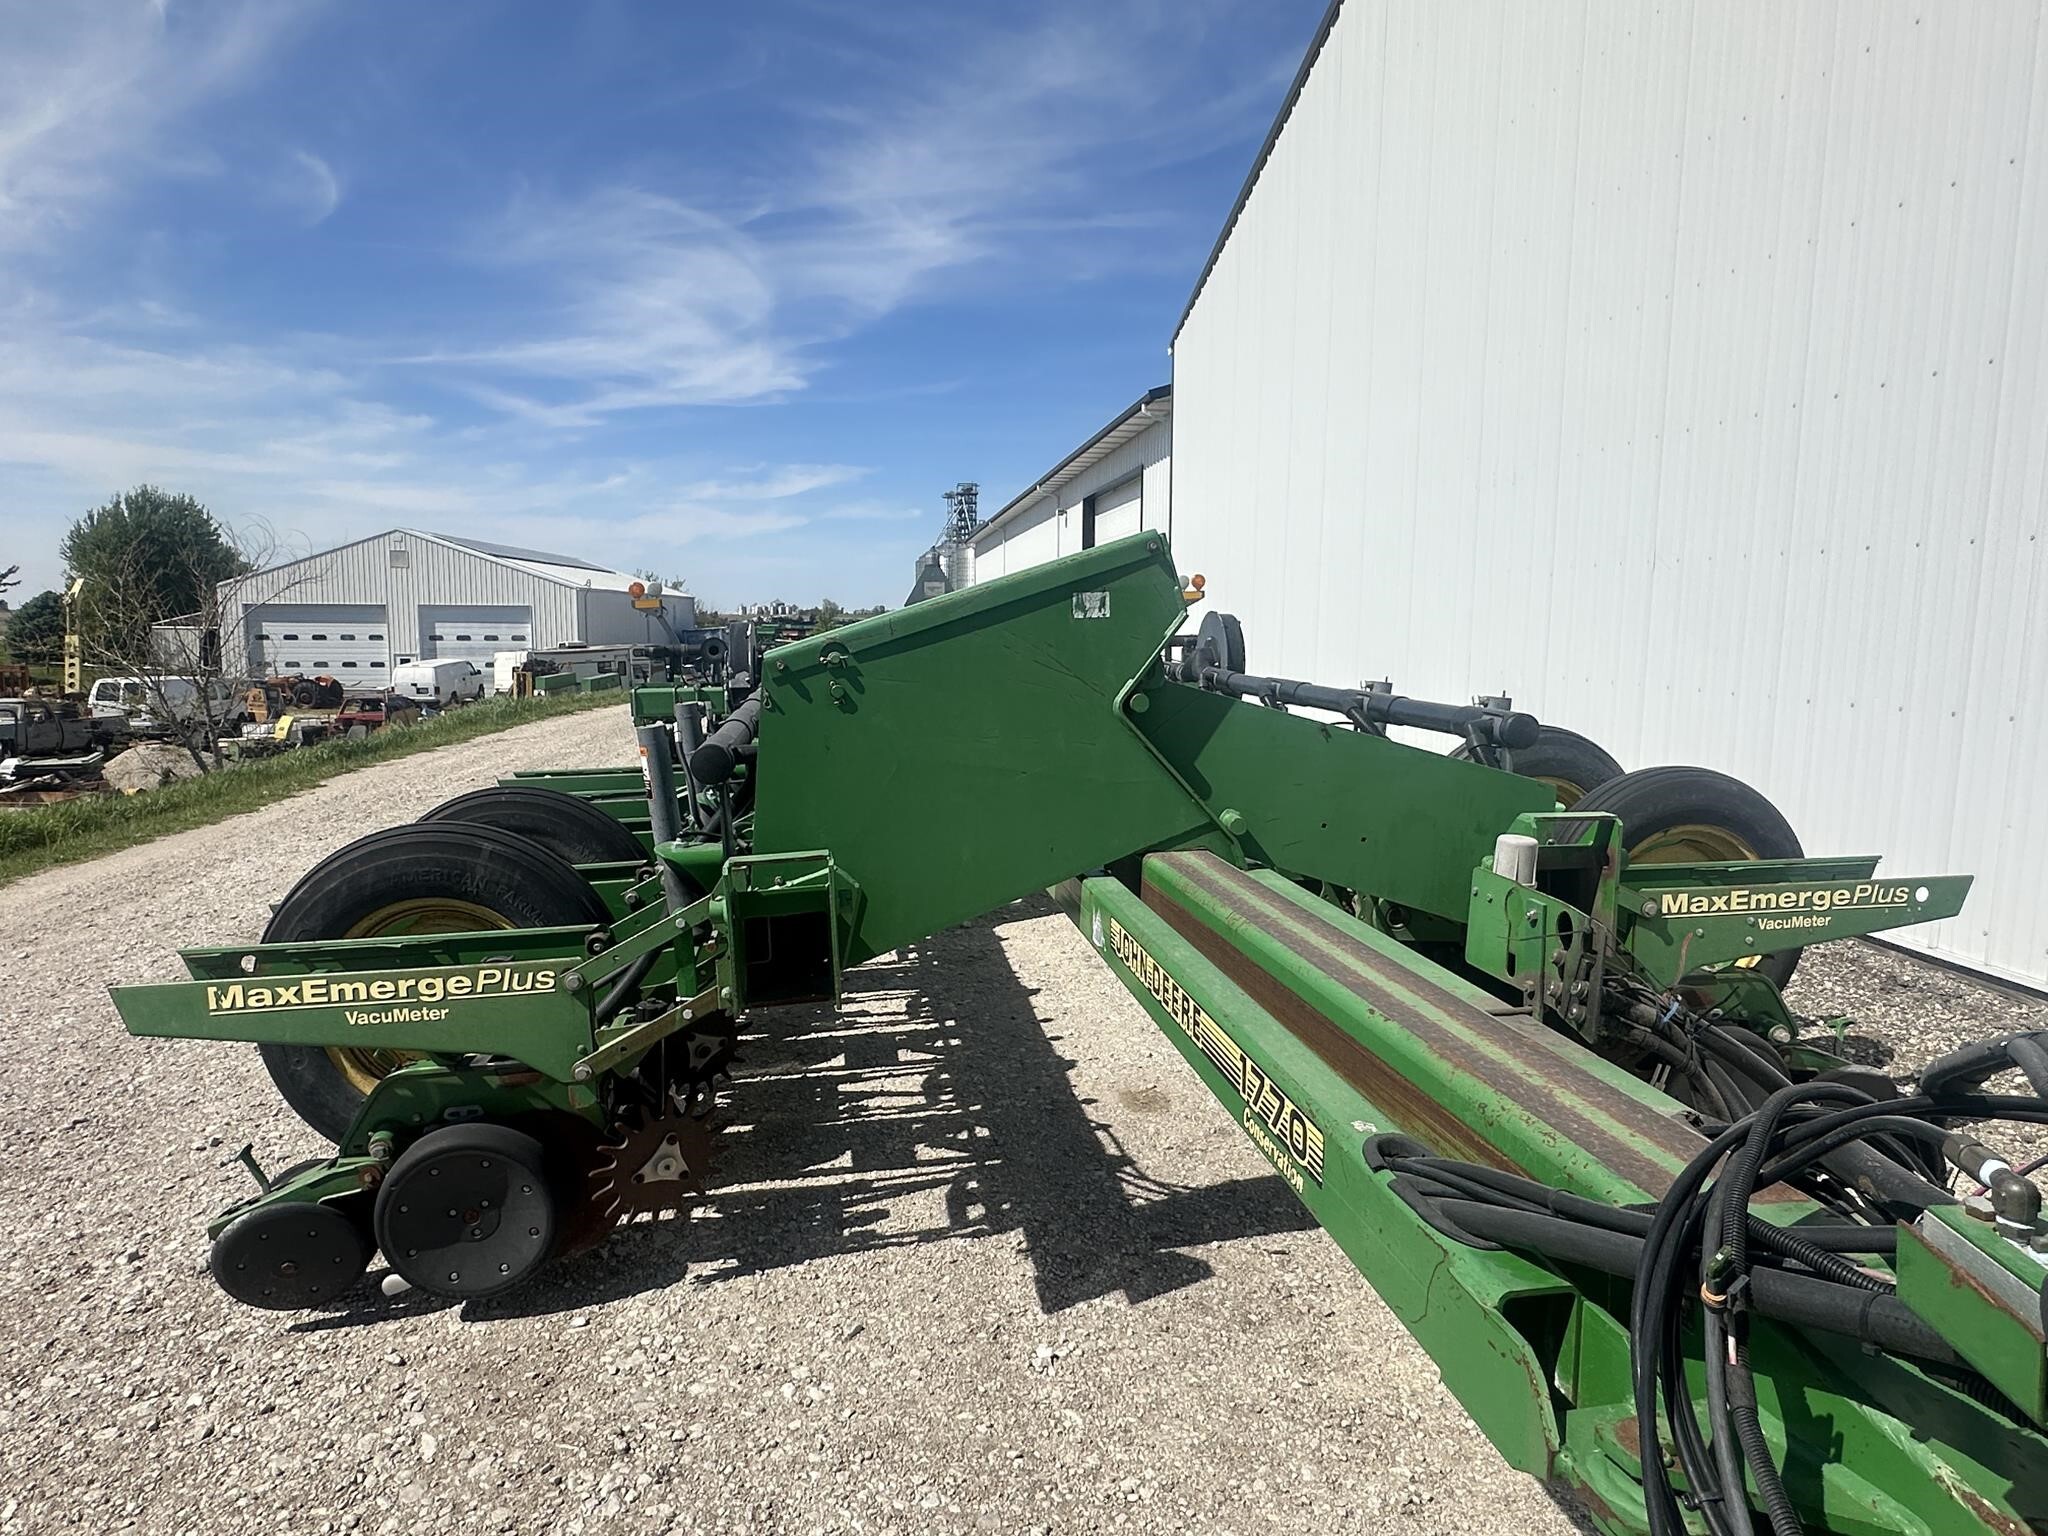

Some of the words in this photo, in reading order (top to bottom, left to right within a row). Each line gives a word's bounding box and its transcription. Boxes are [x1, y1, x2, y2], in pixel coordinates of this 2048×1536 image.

[496, 884, 547, 927] FARME
[1661, 884, 1909, 914] MaxEmergePlus
[1757, 915, 1832, 931] VacuMeter
[207, 967, 556, 1010] MaxEmergePlus
[1115, 925, 1149, 985] JOHN
[1152, 961, 1202, 1045] DEERE
[345, 1005, 449, 1026] VacuMeter
[1239, 1052, 1308, 1162] 1770
[1243, 1106, 1304, 1194] Conservation
